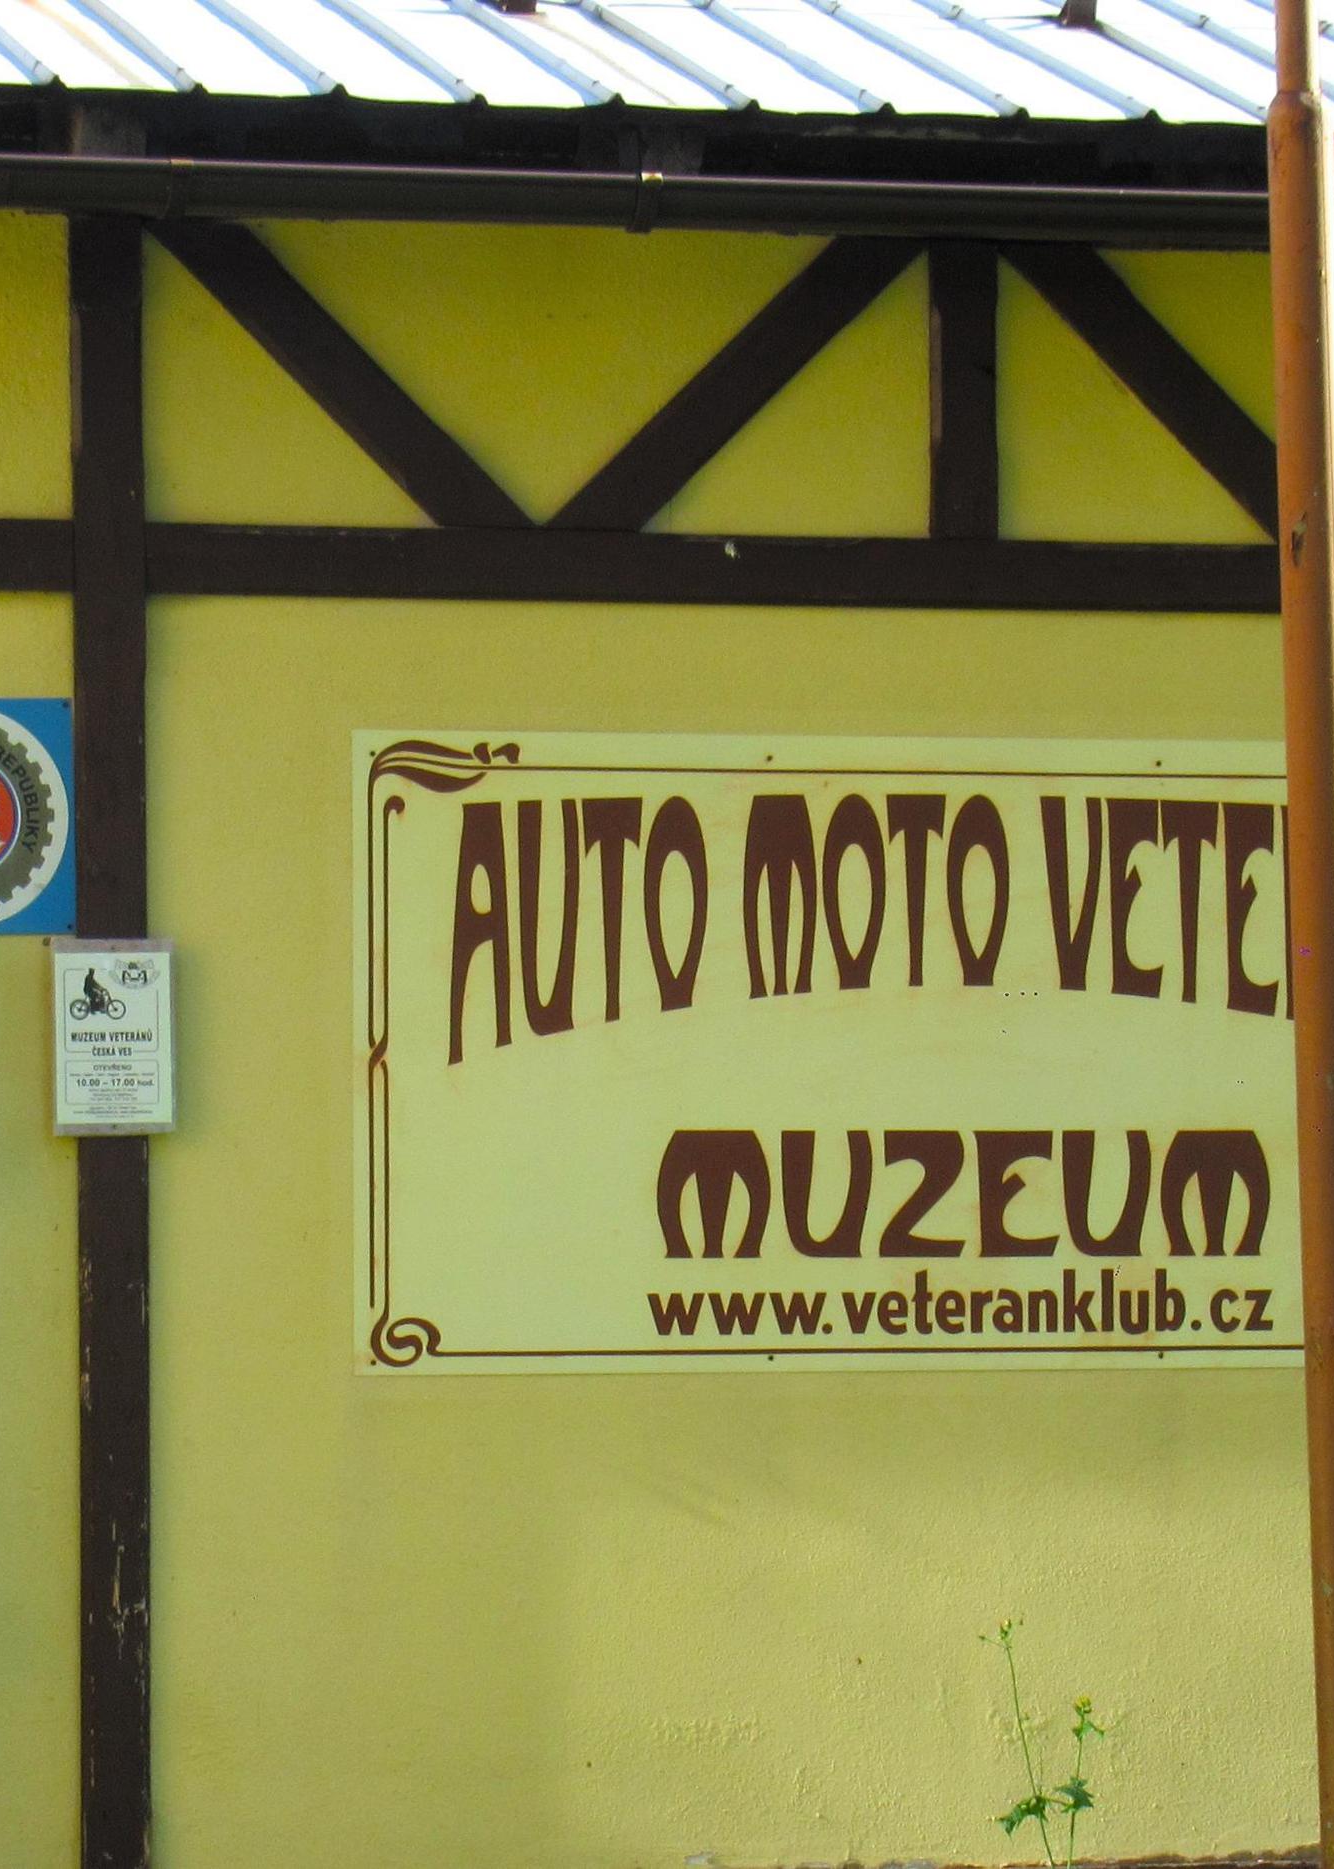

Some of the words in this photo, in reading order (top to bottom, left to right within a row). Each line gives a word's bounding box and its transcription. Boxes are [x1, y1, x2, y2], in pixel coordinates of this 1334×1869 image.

[448, 795, 708, 1065] AUTO
[743, 793, 1009, 999] MOTO
[71, 1031, 106, 1042] MUZEUM
[109, 1028, 153, 1042] VETERÁNŮ
[92, 1044, 116, 1056] ČESKÁ
[118, 1046, 132, 1056] VES
[76, 1078, 100, 1087] 10.00
[111, 1078, 135, 1087] 17.00
[657, 1130, 1270, 1258] MUZEUM
[648, 1269, 1274, 1338] www.veteranklub.cz
